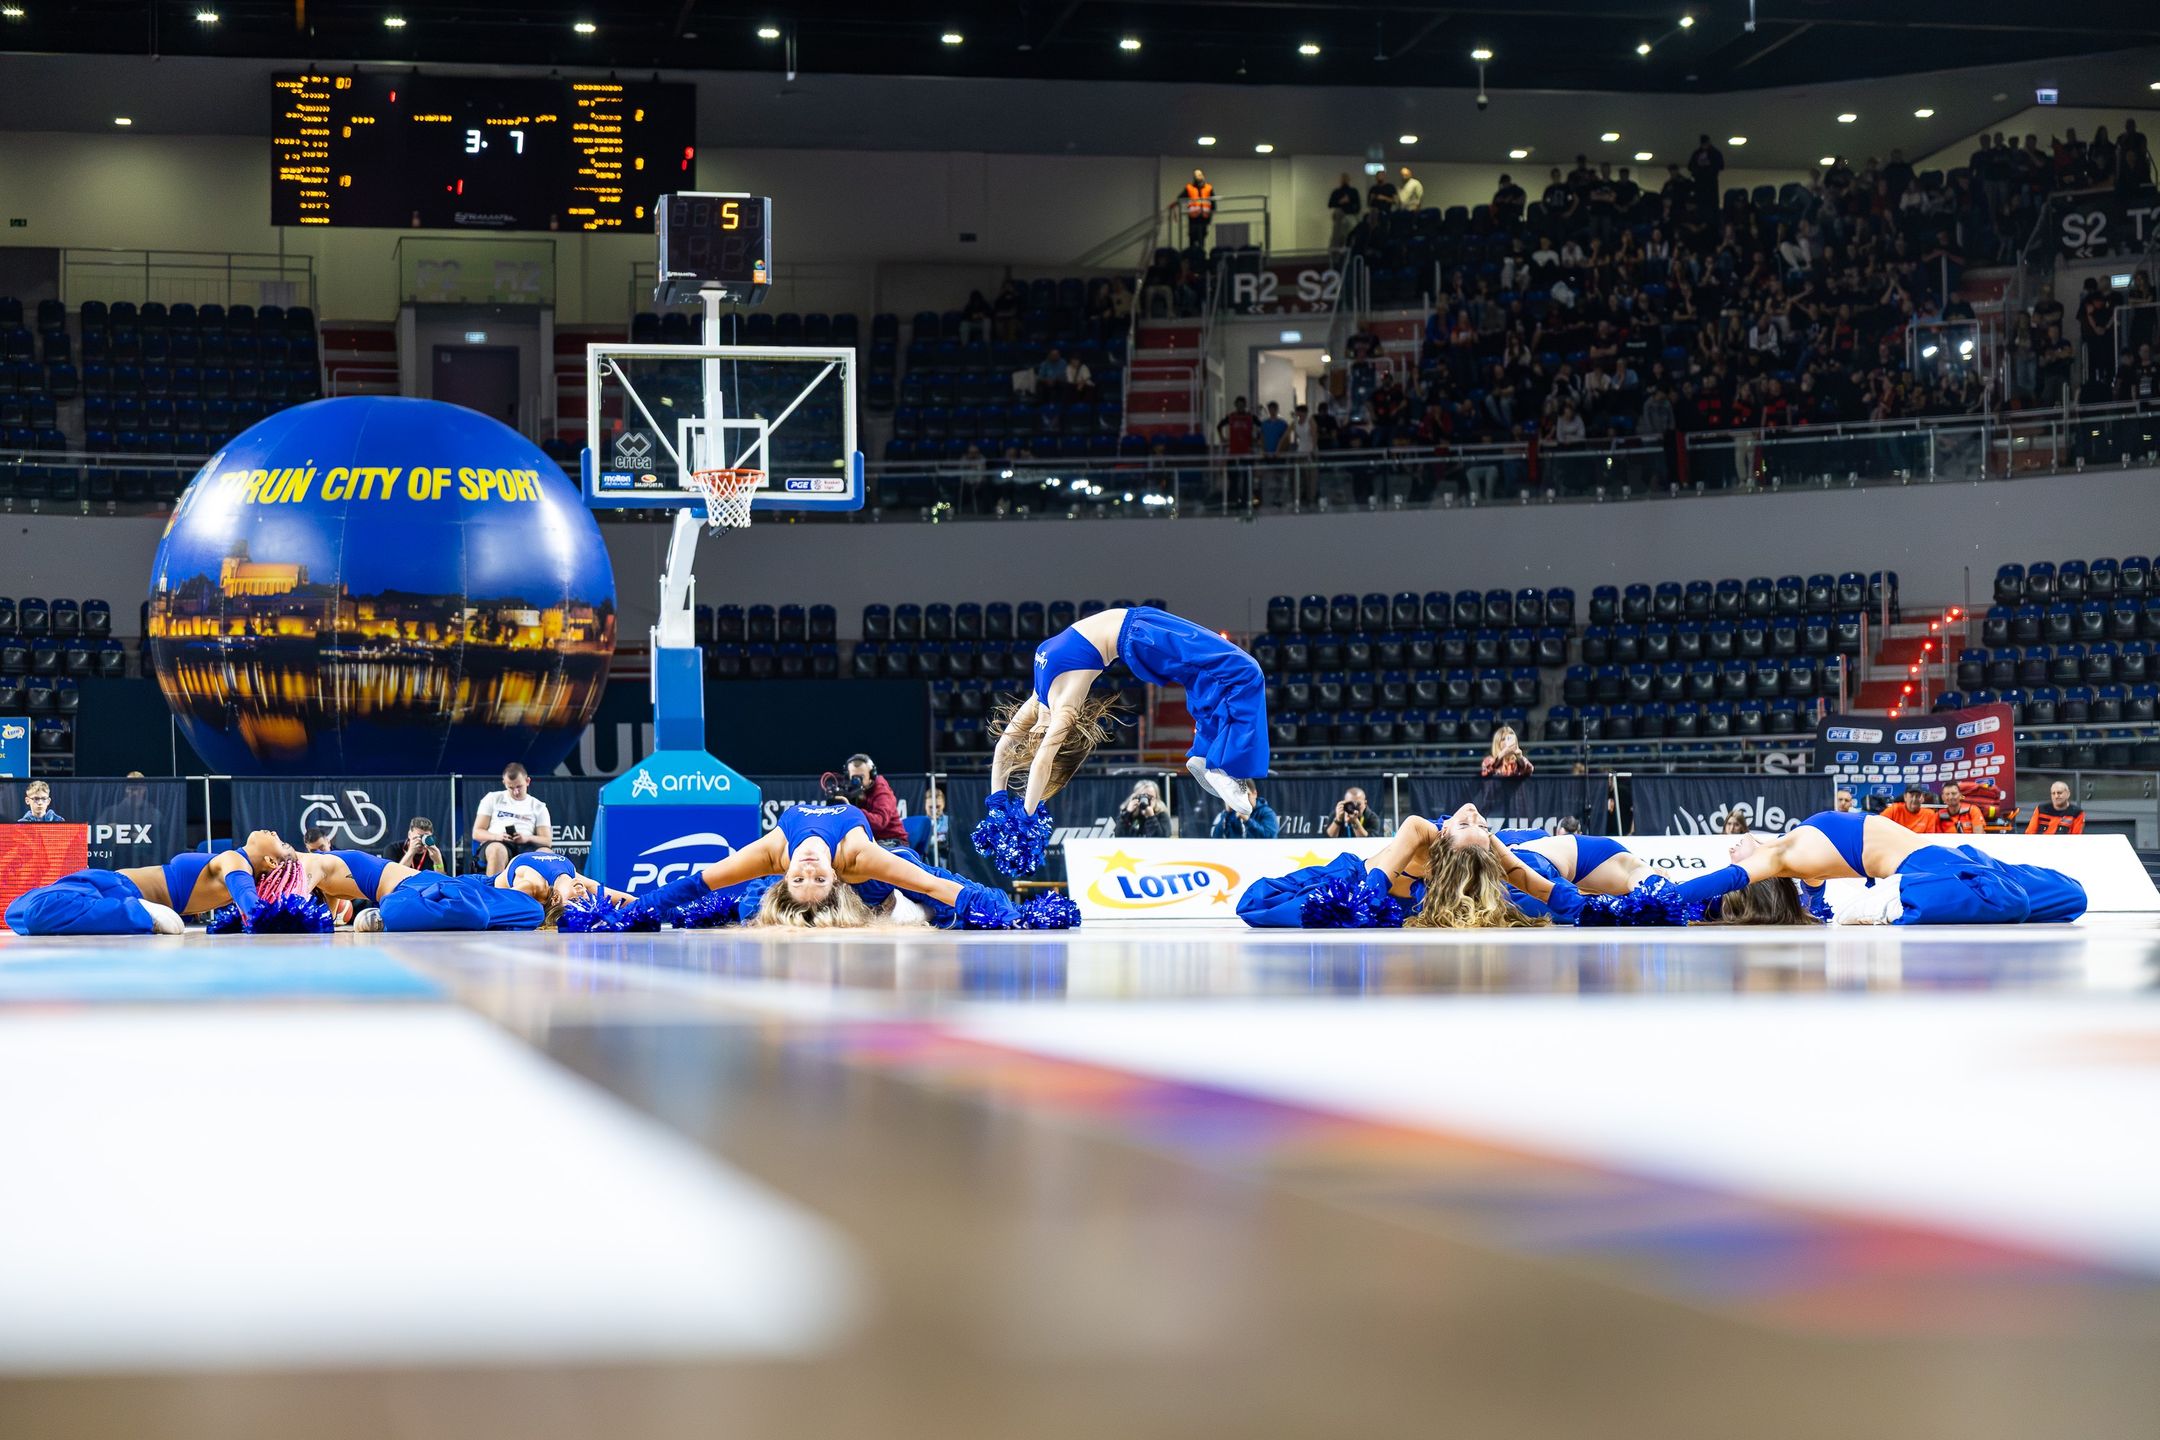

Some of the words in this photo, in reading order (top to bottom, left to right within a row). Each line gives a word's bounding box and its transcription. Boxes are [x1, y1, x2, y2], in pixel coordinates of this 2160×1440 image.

[721, 202, 739, 230] 5
[2062, 211, 2107, 249] S2
[1233, 271, 1279, 304] R2
[1297, 269, 1341, 303] S2
[321, 467, 402, 501] CITY
[408, 467, 451, 501] OF
[458, 468, 545, 502] SPORT
[604, 474, 631, 482] molten
[790, 481, 810, 489] PGE
[1764, 752, 1806, 775] S1
[661, 771, 731, 791] arriva
[87, 824, 152, 844] PEX
[551, 825, 585, 840] EAN
[1276, 815, 1311, 834] Villa
[1117, 870, 1210, 899] LOTTO
